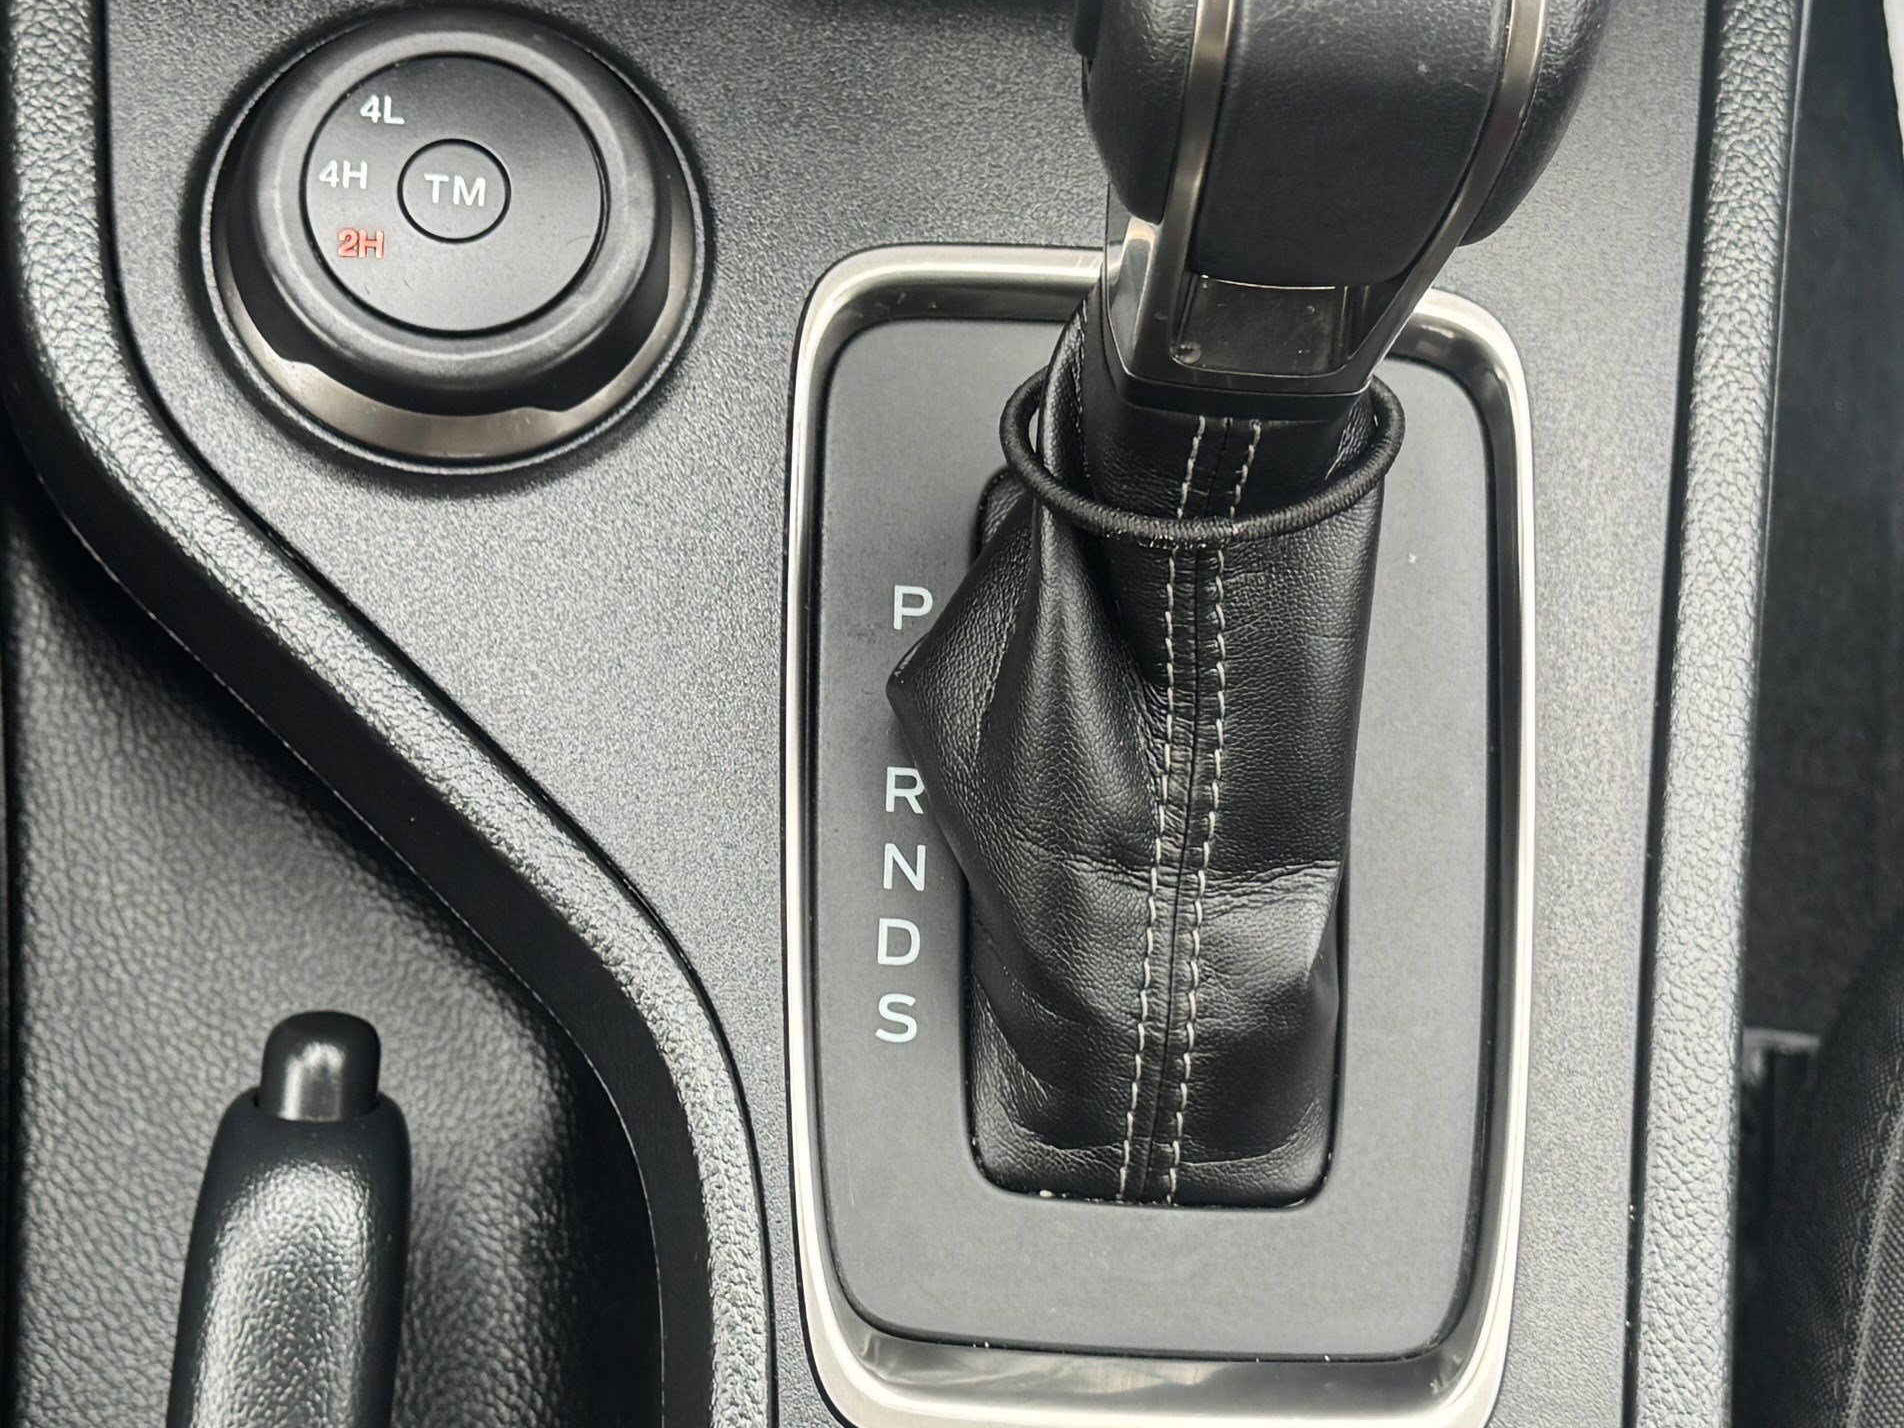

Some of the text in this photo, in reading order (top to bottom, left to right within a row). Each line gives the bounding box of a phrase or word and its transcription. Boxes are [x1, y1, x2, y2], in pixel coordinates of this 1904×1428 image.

[360, 95, 405, 127] 4L
[318, 160, 369, 191] 4H
[424, 174, 487, 208] TM
[336, 229, 385, 260] 2H
[893, 585, 934, 630] P
[885, 766, 925, 815] R
[882, 843, 925, 891] N
[877, 918, 921, 965] D
[875, 993, 918, 1043] S
